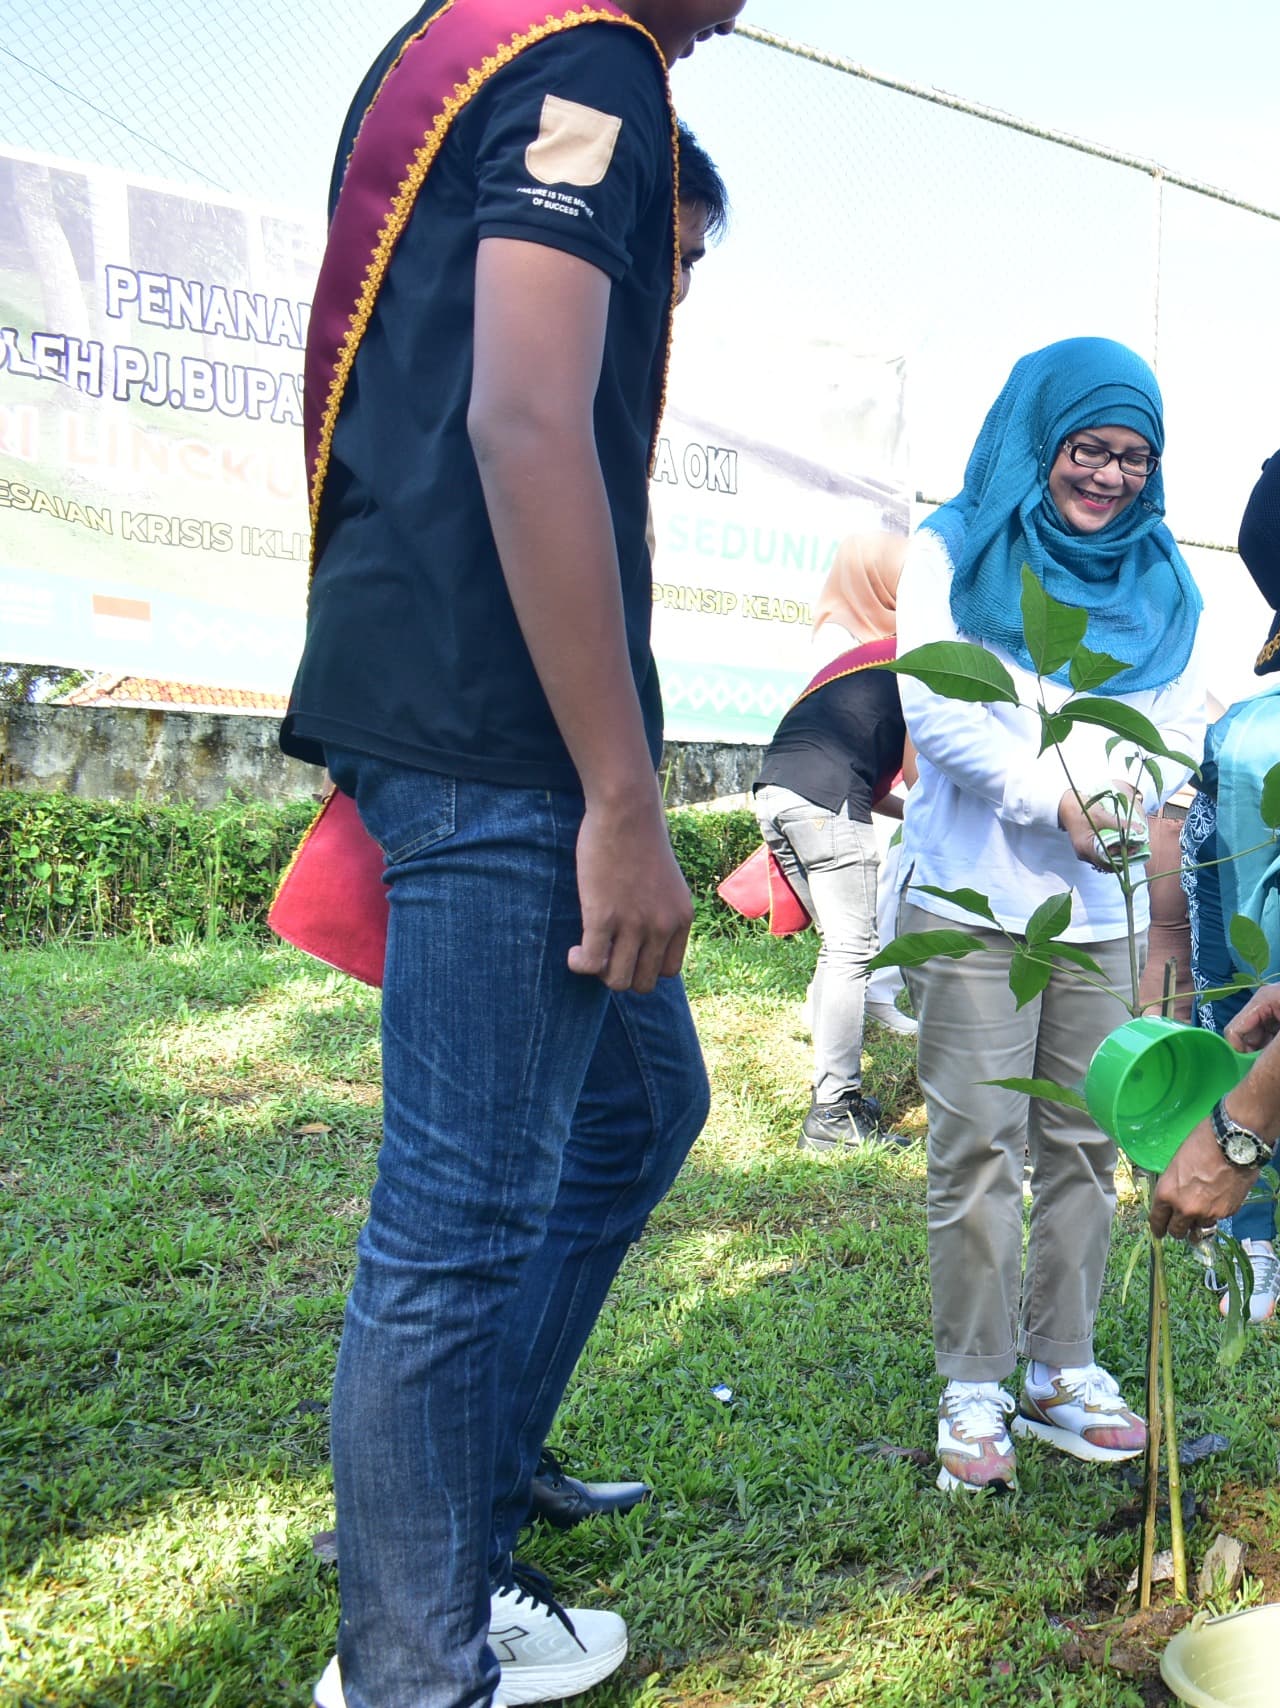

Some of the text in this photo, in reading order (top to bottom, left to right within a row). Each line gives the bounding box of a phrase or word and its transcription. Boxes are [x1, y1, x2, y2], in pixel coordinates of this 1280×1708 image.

[532, 197, 579, 216] OF SUCCESS
[0, 326, 103, 397] LEH
[113, 346, 305, 427] PJ.BUPA
[683, 442, 738, 495] OKI
[121, 511, 233, 553] KRISIS
